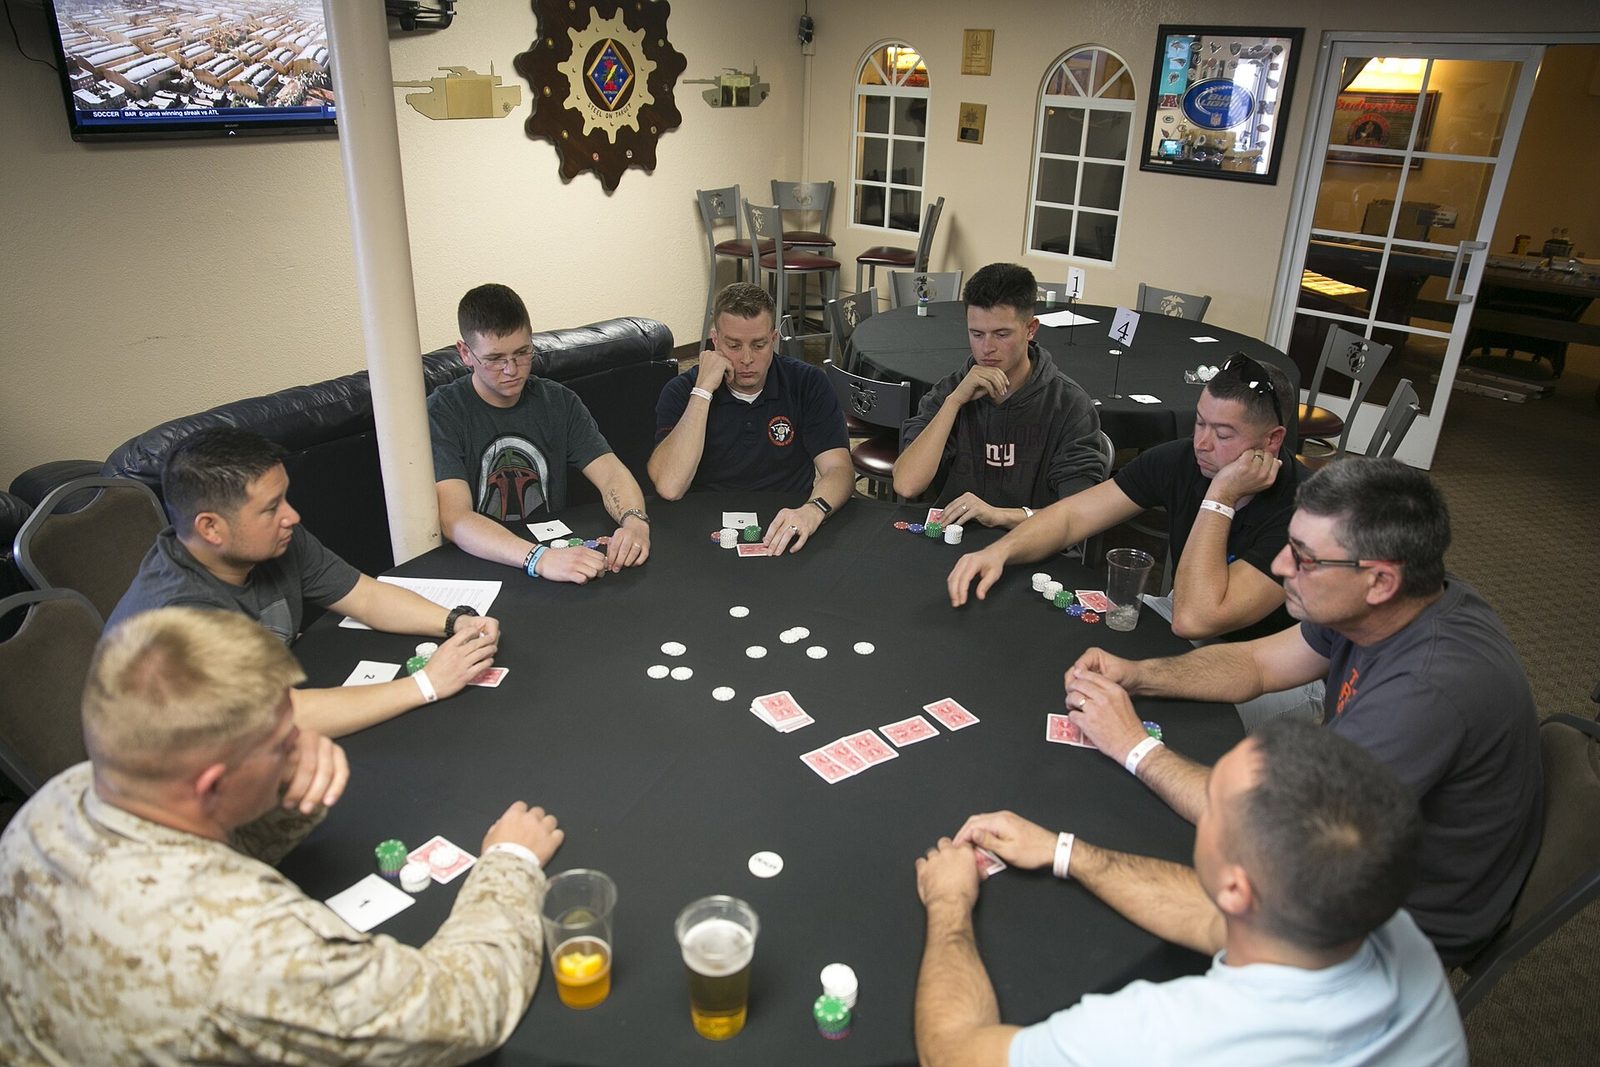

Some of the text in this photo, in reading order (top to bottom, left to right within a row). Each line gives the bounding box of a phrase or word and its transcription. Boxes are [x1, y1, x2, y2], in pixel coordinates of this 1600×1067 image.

[588, 102, 602, 117] STEEL
[615, 103, 632, 117] TARGET
[1201, 99, 1230, 107] LIGH
[138, 110, 161, 118] 6-game
[1072, 276, 1080, 293] 1
[1117, 321, 1130, 341] 4
